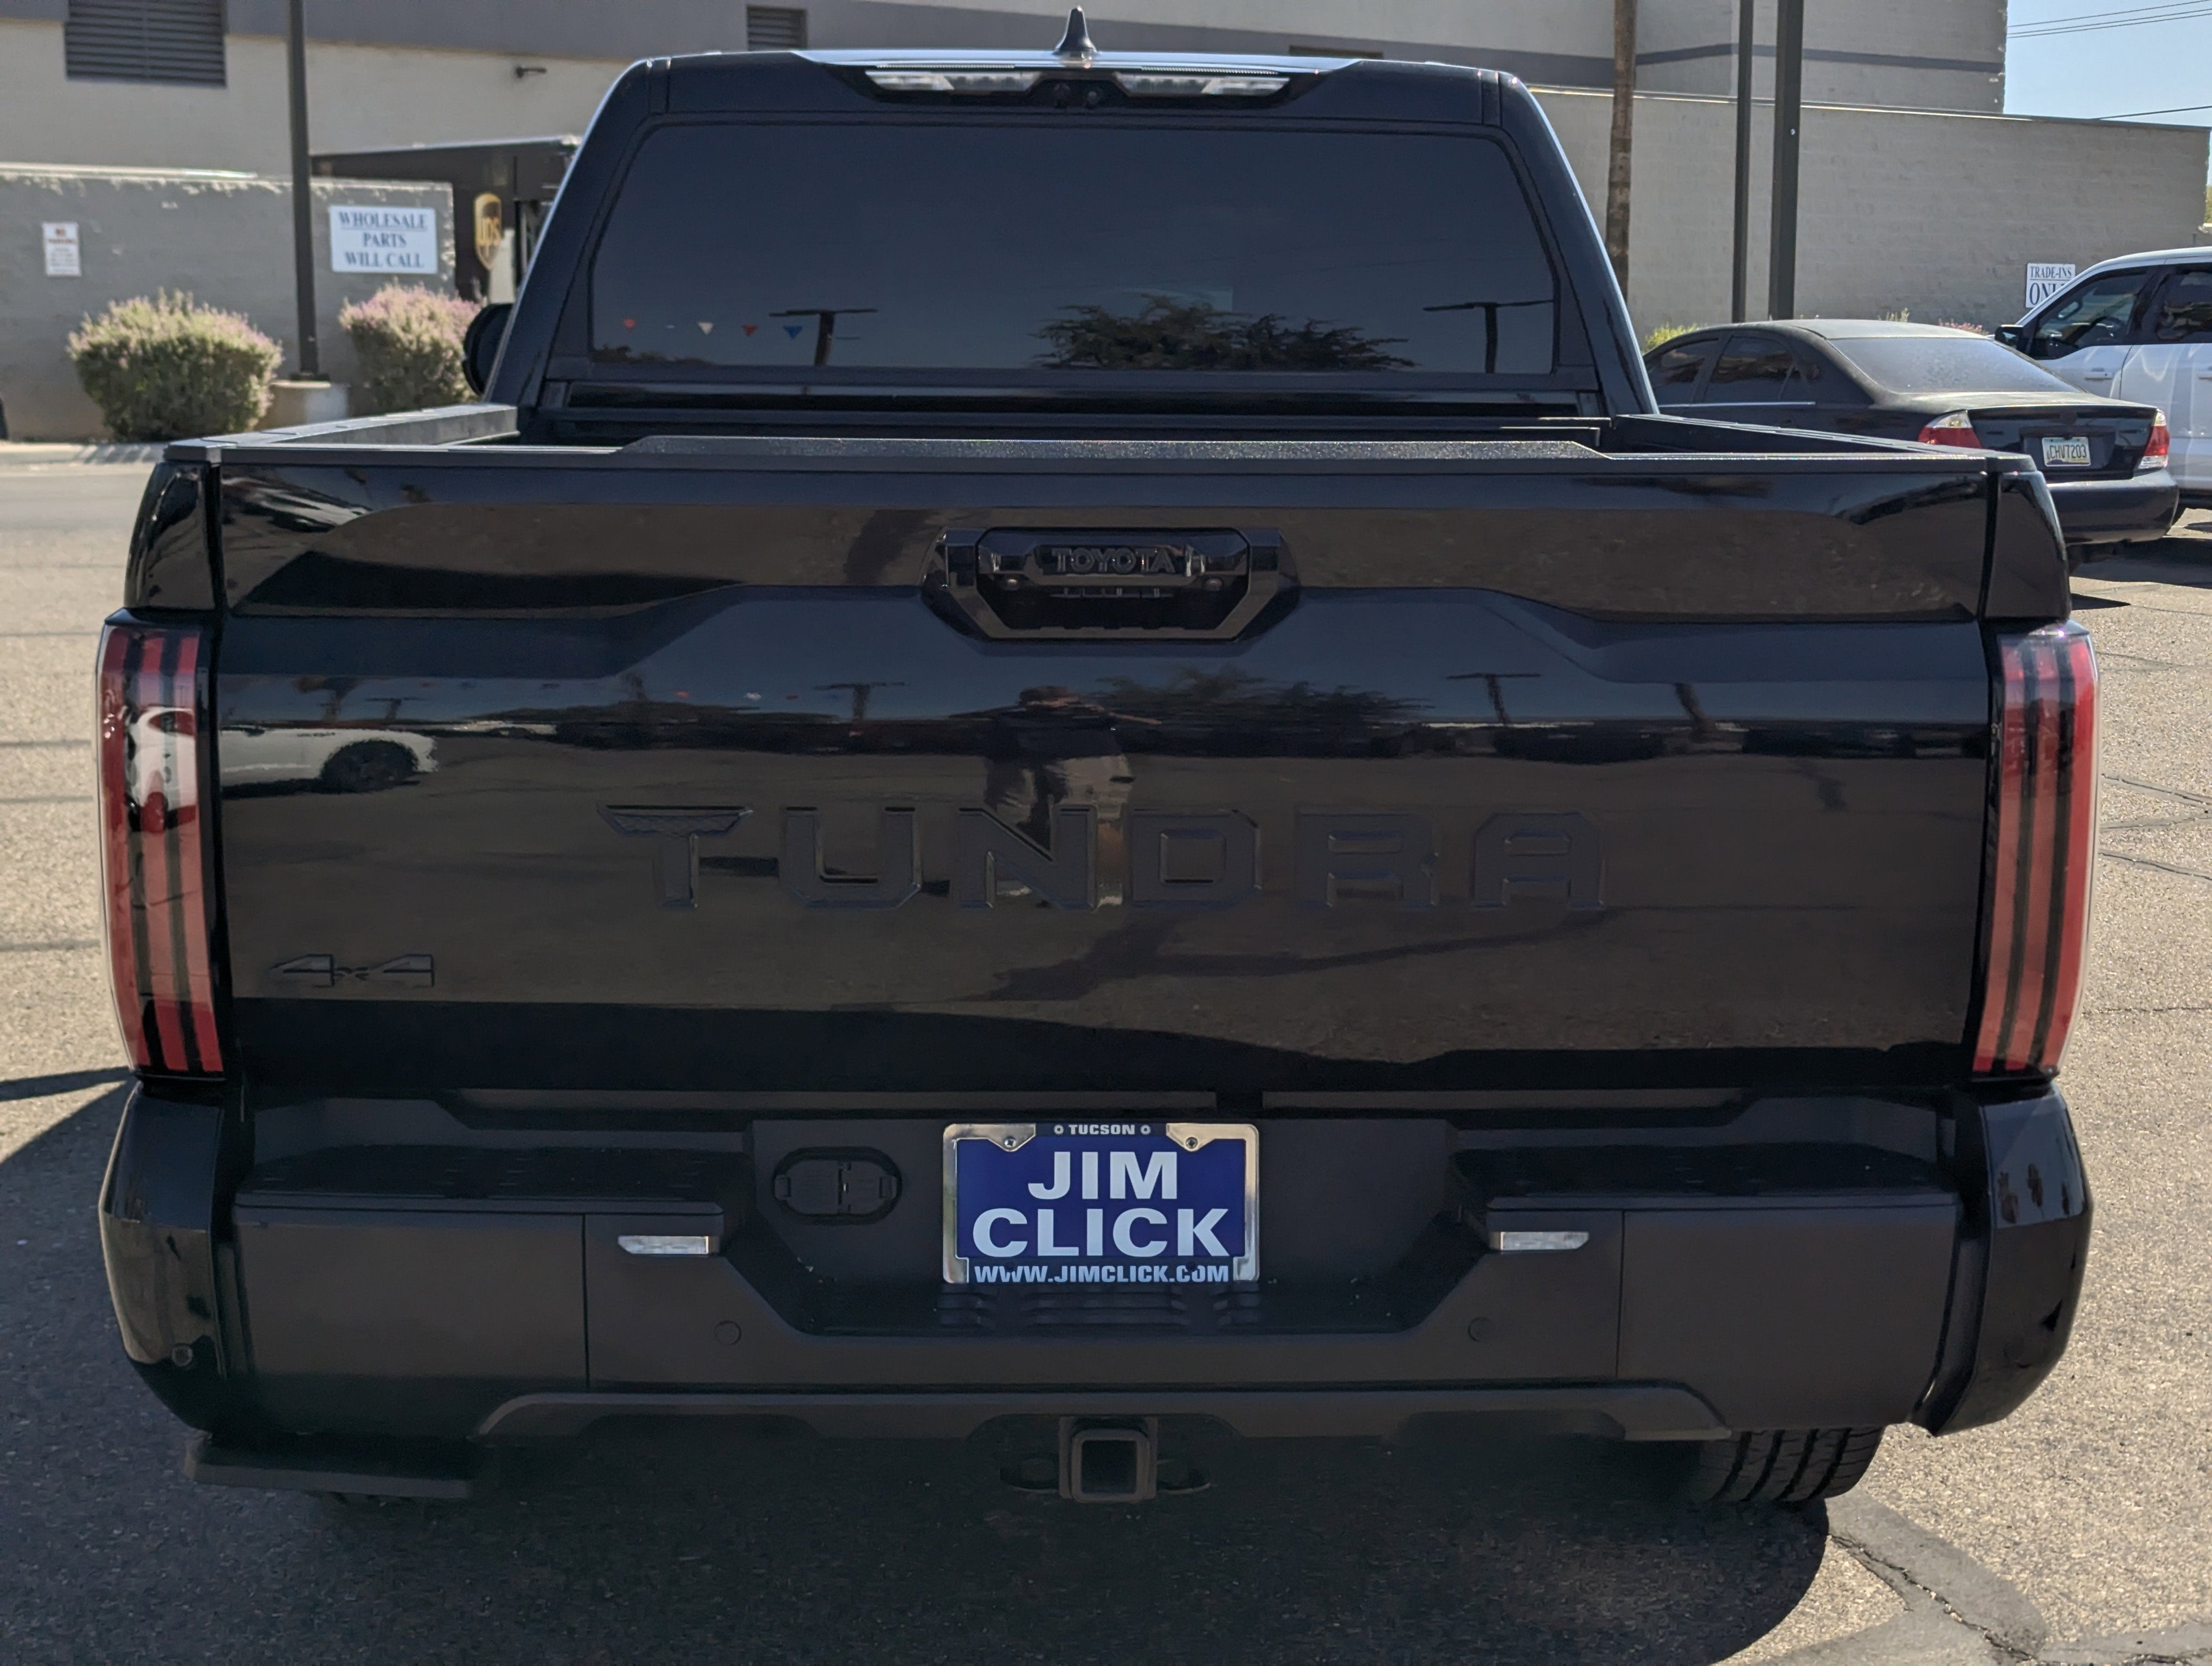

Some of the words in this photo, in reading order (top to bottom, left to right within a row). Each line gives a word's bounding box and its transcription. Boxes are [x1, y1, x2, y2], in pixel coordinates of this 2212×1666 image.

[339, 212, 427, 228] WHOLESALE
[363, 232, 406, 246] PARTS
[344, 252, 382, 266] WILL
[386, 253, 424, 267] CALL
[2030, 266, 2072, 279] TRADE-INS
[2030, 283, 2065, 305] ON
[2050, 444, 2087, 459] CHV7203
[1052, 548, 1175, 573] TOYOTA
[596, 804, 1606, 911] TUNDRA
[1069, 1124, 1135, 1135] TUCSON
[1028, 1151, 1177, 1199] JIM
[973, 1208, 1229, 1257] CLICK
[974, 1265, 1229, 1283] WWW.JIMCLICK.COM
